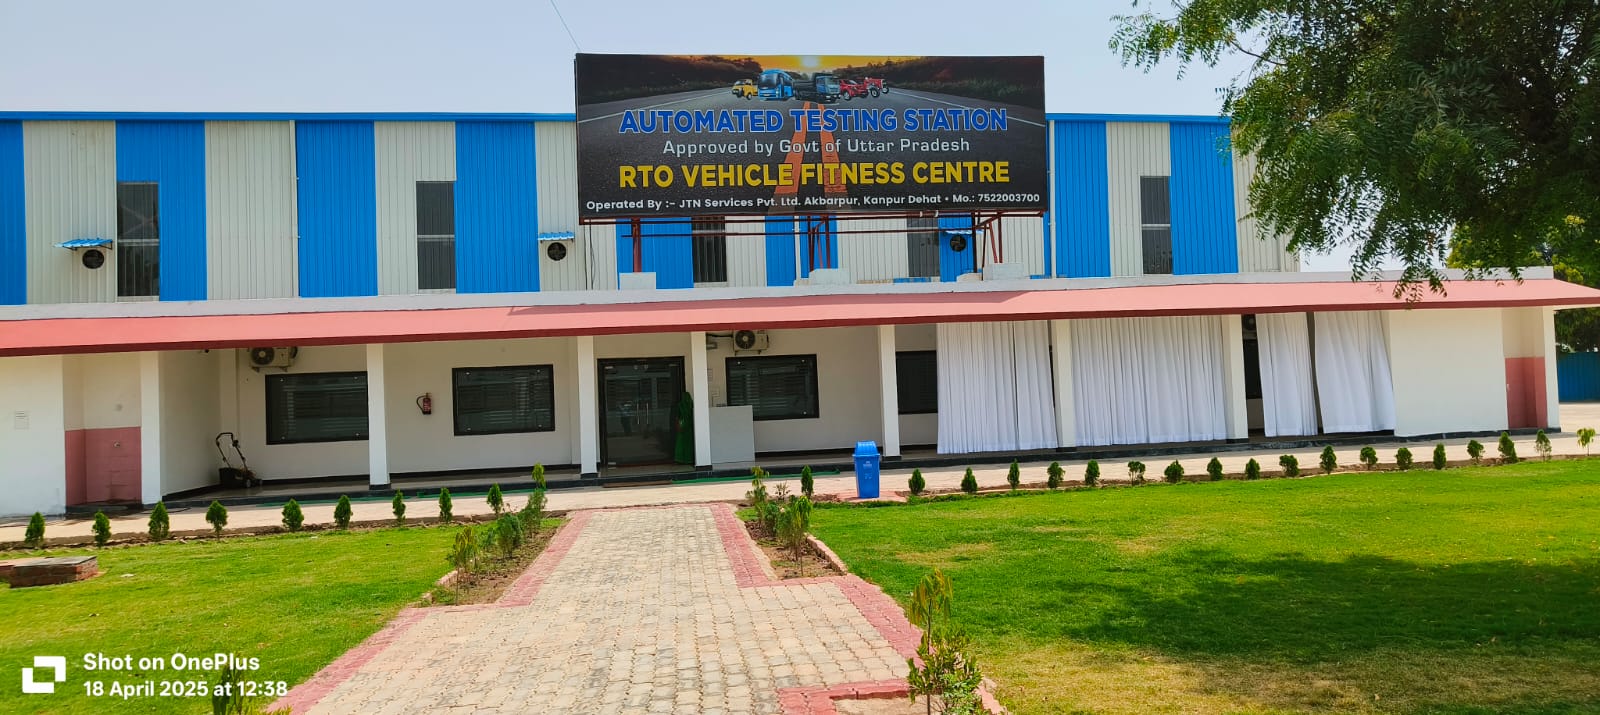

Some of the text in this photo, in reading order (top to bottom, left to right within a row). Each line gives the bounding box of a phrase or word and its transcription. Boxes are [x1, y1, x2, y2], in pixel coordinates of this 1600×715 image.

[619, 108, 1008, 134] AUTOMATED TESTING STATION
[663, 138, 970, 158] Approved by Govt of Uttar Pradesh
[619, 161, 1010, 188] RTO VEHICLE FITNESS CENTRE
[586, 199, 644, 212] Operated
[647, 199, 662, 211] By
[679, 199, 701, 208] JTN
[704, 197, 754, 208] Services
[756, 197, 778, 207] Pvt.
[781, 196, 801, 206] Ltd.
[804, 196, 861, 207] Akbarpur,
[863, 195, 906, 207] Kanpur
[908, 194, 942, 204] Dehat
[952, 194, 975, 203] Mo.:
[978, 193, 1040, 202] 7522003700
